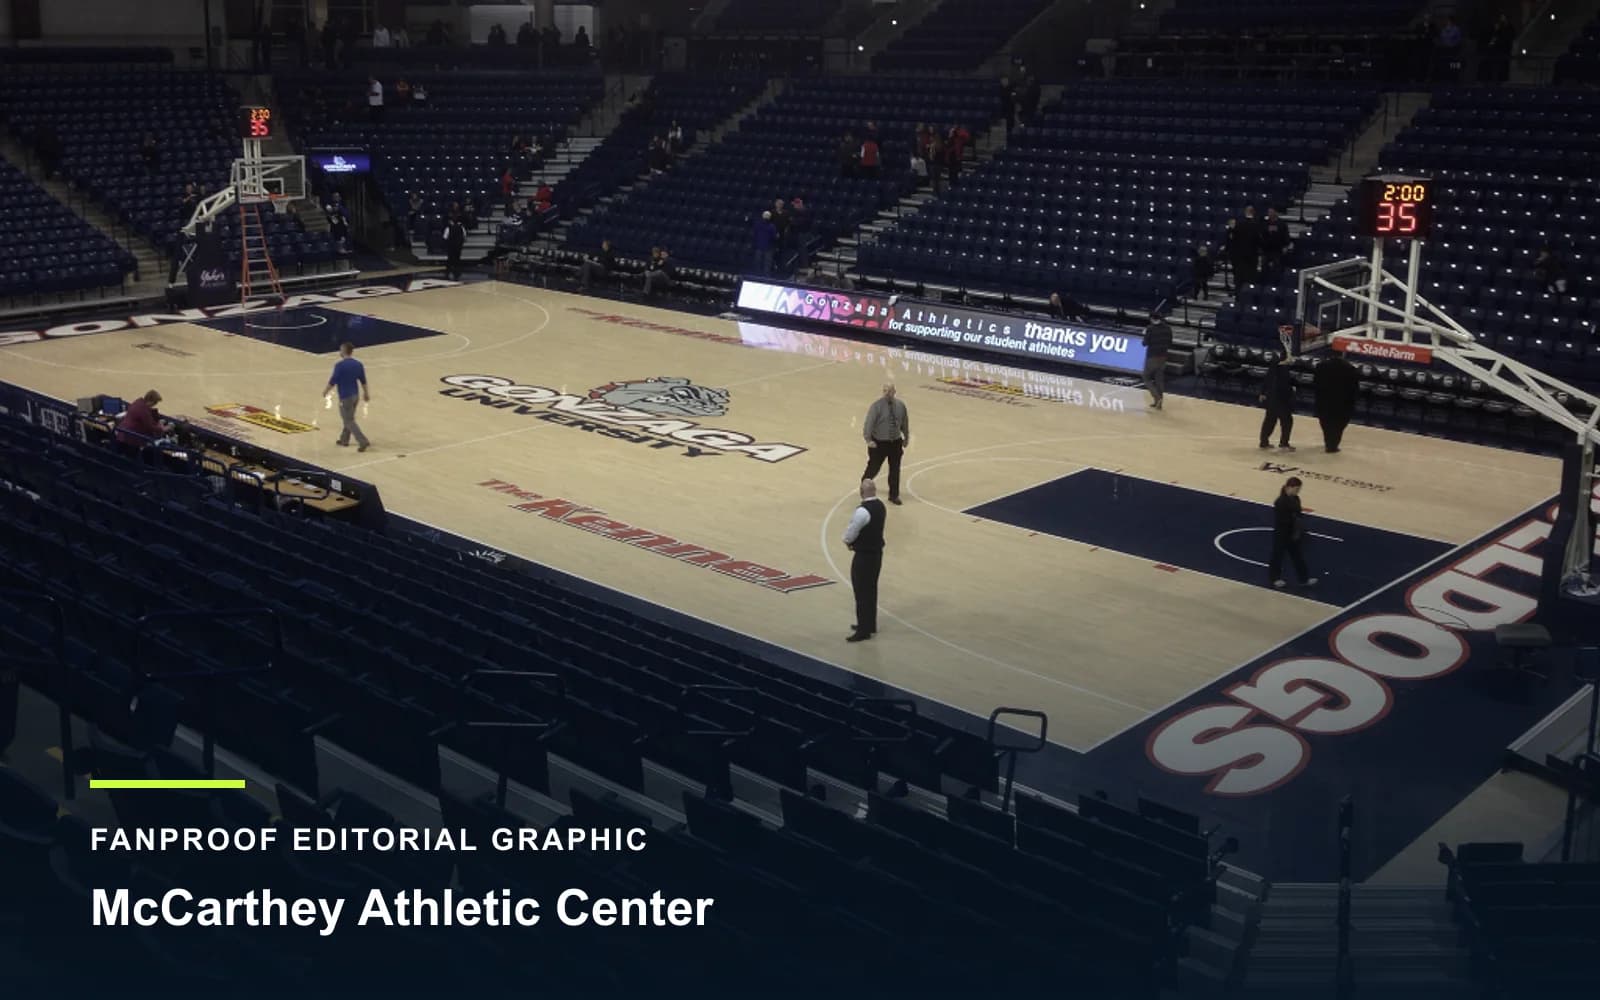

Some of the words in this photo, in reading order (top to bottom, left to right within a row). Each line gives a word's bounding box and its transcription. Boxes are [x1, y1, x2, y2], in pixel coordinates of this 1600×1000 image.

[1376, 202, 1417, 232] 35
[1383, 184, 1425, 202] 2:00
[804, 294, 888, 316] Gonzaga
[902, 308, 1011, 335] Athletics
[1023, 321, 1087, 347] thanks
[1089, 334, 1129, 353] you
[888, 317, 904, 330] for
[904, 322, 961, 342] supporting
[963, 332, 983, 344] our
[984, 334, 1028, 351] student
[1028, 341, 1075, 359] athletes
[438, 386, 724, 456] UNIVERSITY
[440, 374, 808, 463] GONZAGA
[477, 479, 543, 501] The
[507, 497, 838, 594] Kennel
